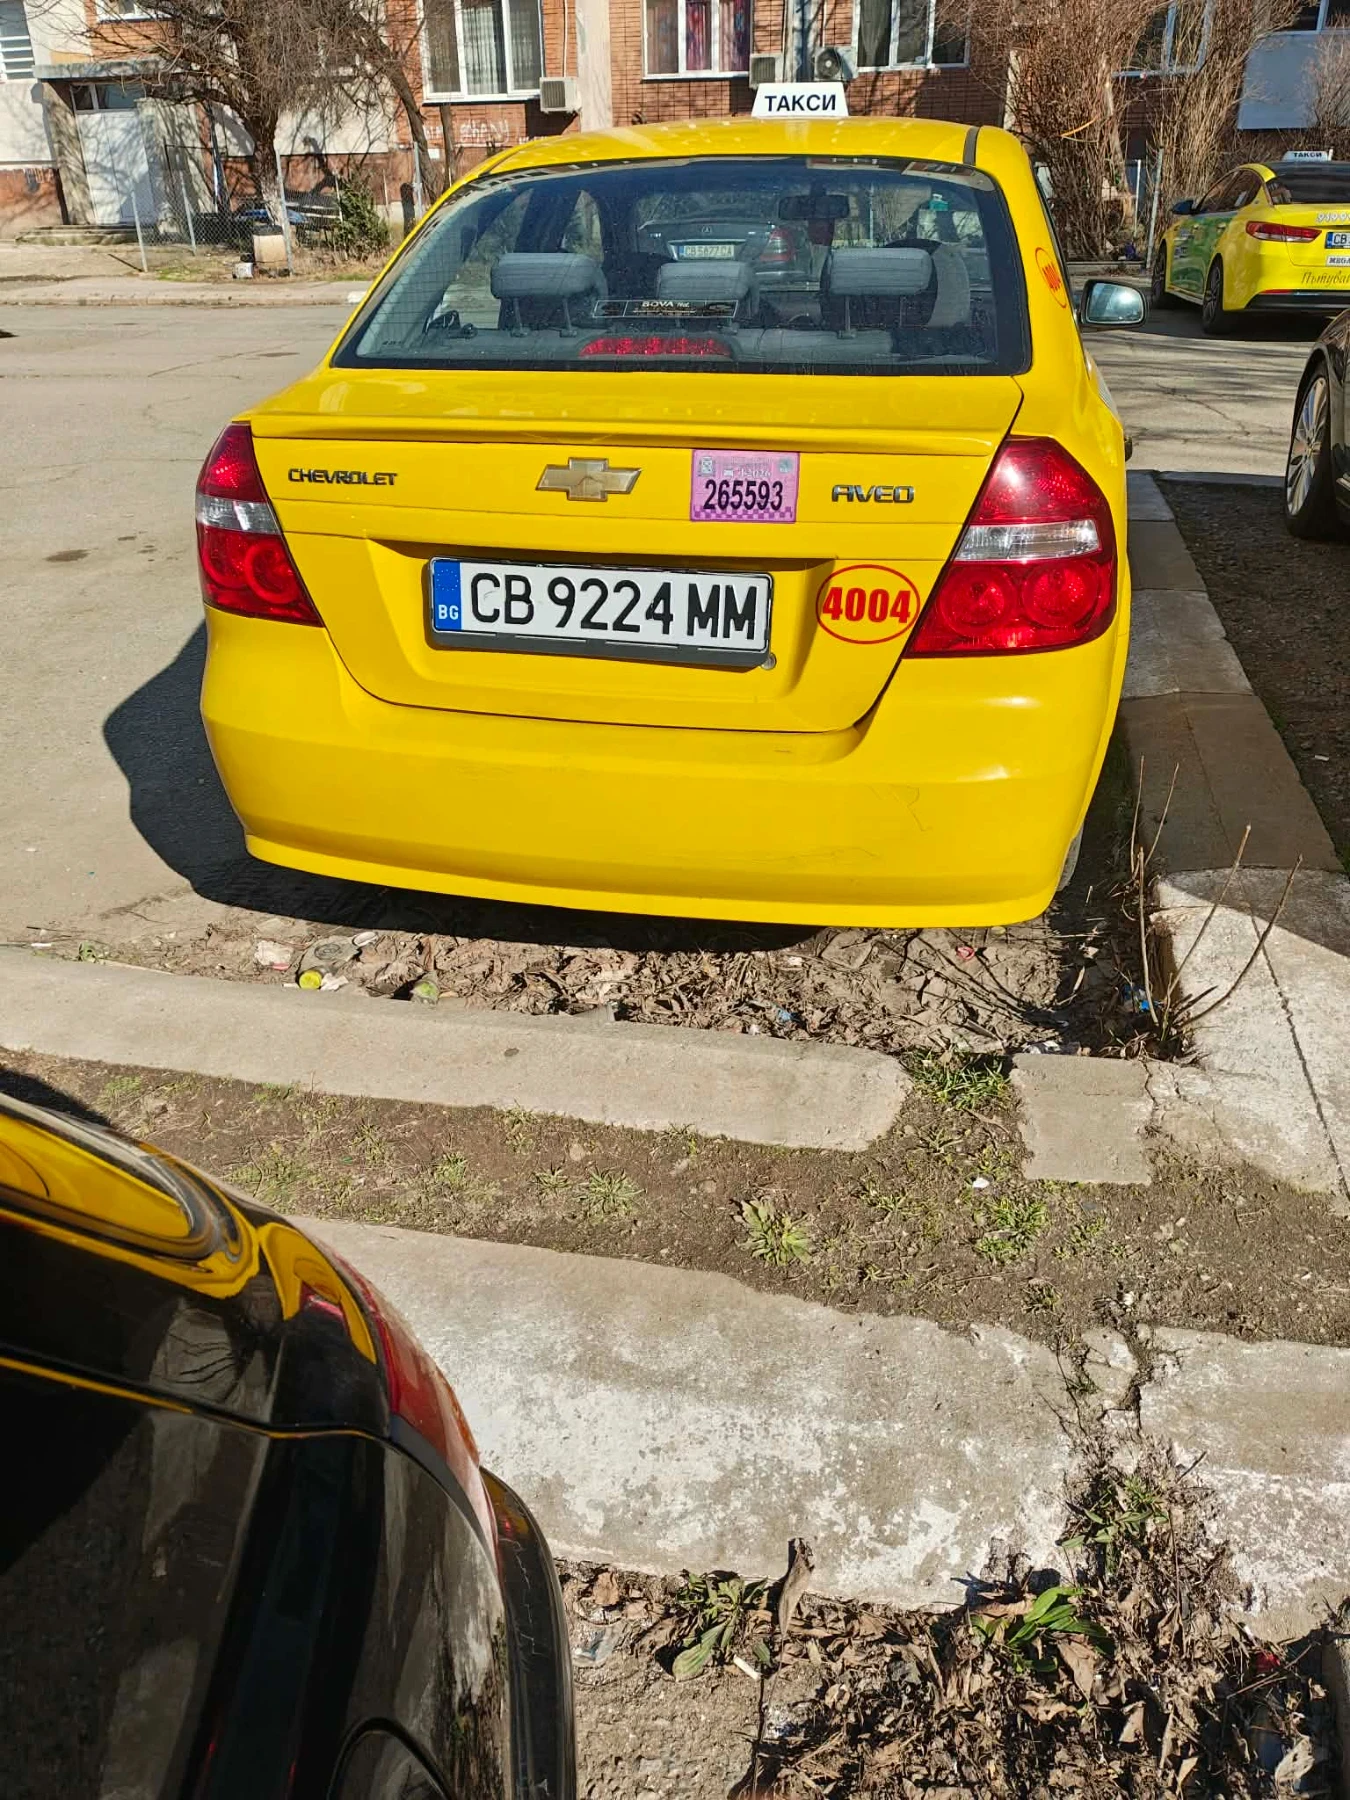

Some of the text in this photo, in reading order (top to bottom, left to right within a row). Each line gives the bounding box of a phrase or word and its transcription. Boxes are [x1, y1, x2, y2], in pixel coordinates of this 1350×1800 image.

[764, 94, 836, 112] ТАКСИ
[288, 467, 398, 486] CHEVROLET
[703, 479, 784, 511] 265593
[831, 484, 916, 504] AVEO
[437, 605, 460, 622] BG
[470, 573, 756, 640] CB 9224 MM
[822, 586, 912, 624] 4004
